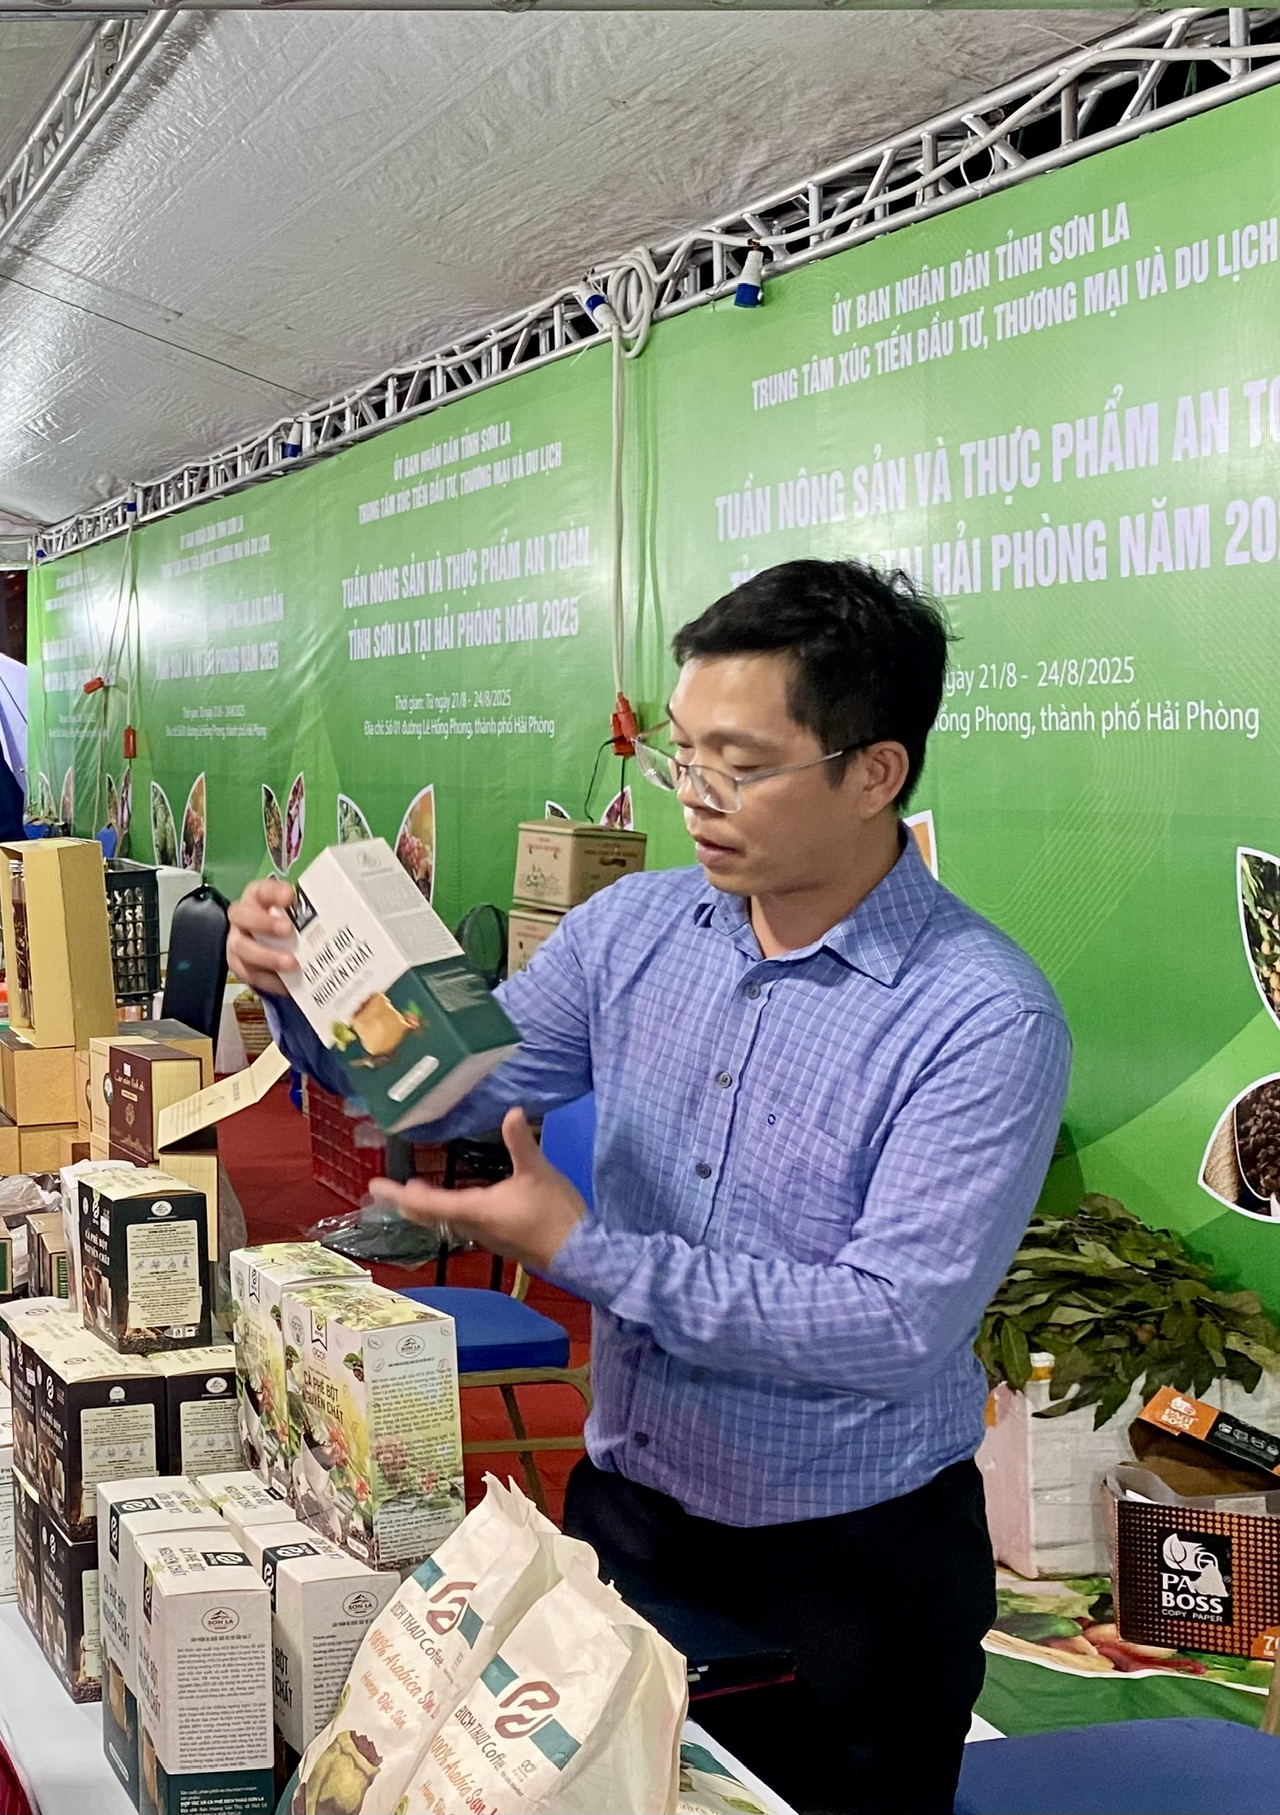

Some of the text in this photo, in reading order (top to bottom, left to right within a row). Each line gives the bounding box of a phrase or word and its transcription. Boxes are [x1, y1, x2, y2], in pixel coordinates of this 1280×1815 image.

[832, 201, 1130, 336] ỦY BAN NHÂN DÂN TỈNH SƠN LA
[751, 216, 1278, 411] TRUNG TÂM XÚC TIẾN ĐẦU TƯ, THƯƠNG MẠI VÀ DU LỊCH
[500, 420, 511, 446] LA
[526, 450, 539, 476] DU
[715, 472, 771, 542] TUẦN
[777, 467, 845, 531] NÔNG
[853, 443, 906, 519] SẢN
[914, 436, 952, 507] VÀ
[960, 425, 1040, 506] THỰC
[1051, 383, 1159, 483] PHẨM
[1172, 387, 1229, 462] AN
[370, 563, 400, 604] NÔNG
[402, 552, 425, 599] SẢN
[428, 550, 443, 593] VÀ
[481, 528, 521, 584] PHẨM
[525, 536, 545, 577] AN
[549, 520, 590, 571] TOÀN
[932, 496, 1280, 597] HẢI PHÒNG NĂM 20
[374, 621, 395, 658] SƠN
[398, 622, 411, 655] LA
[414, 618, 432, 661] TẠI
[435, 603, 454, 650] HẢI
[458, 601, 501, 648] PHÒNG
[505, 595, 538, 643] NĂM
[543, 596, 580, 639] 2025
[978, 663, 1018, 689] 21/8
[1037, 656, 1135, 688] 24/8/2025
[452, 692, 467, 709] 21/8
[474, 689, 511, 709] 24/8/2025
[975, 706, 1036, 740] Phong,
[1040, 701, 1095, 732] thành
[1102, 699, 1141, 739] phố
[1147, 700, 1181, 731] Hải
[1186, 699, 1260, 739] Phòng
[514, 715, 528, 734] Hải
[529, 716, 555, 739] Phòng
[1162, 1591, 1224, 1614] BOSS
[1162, 1608, 1223, 1623] COPY PAPER
[382, 1653, 423, 1698] Arabica
